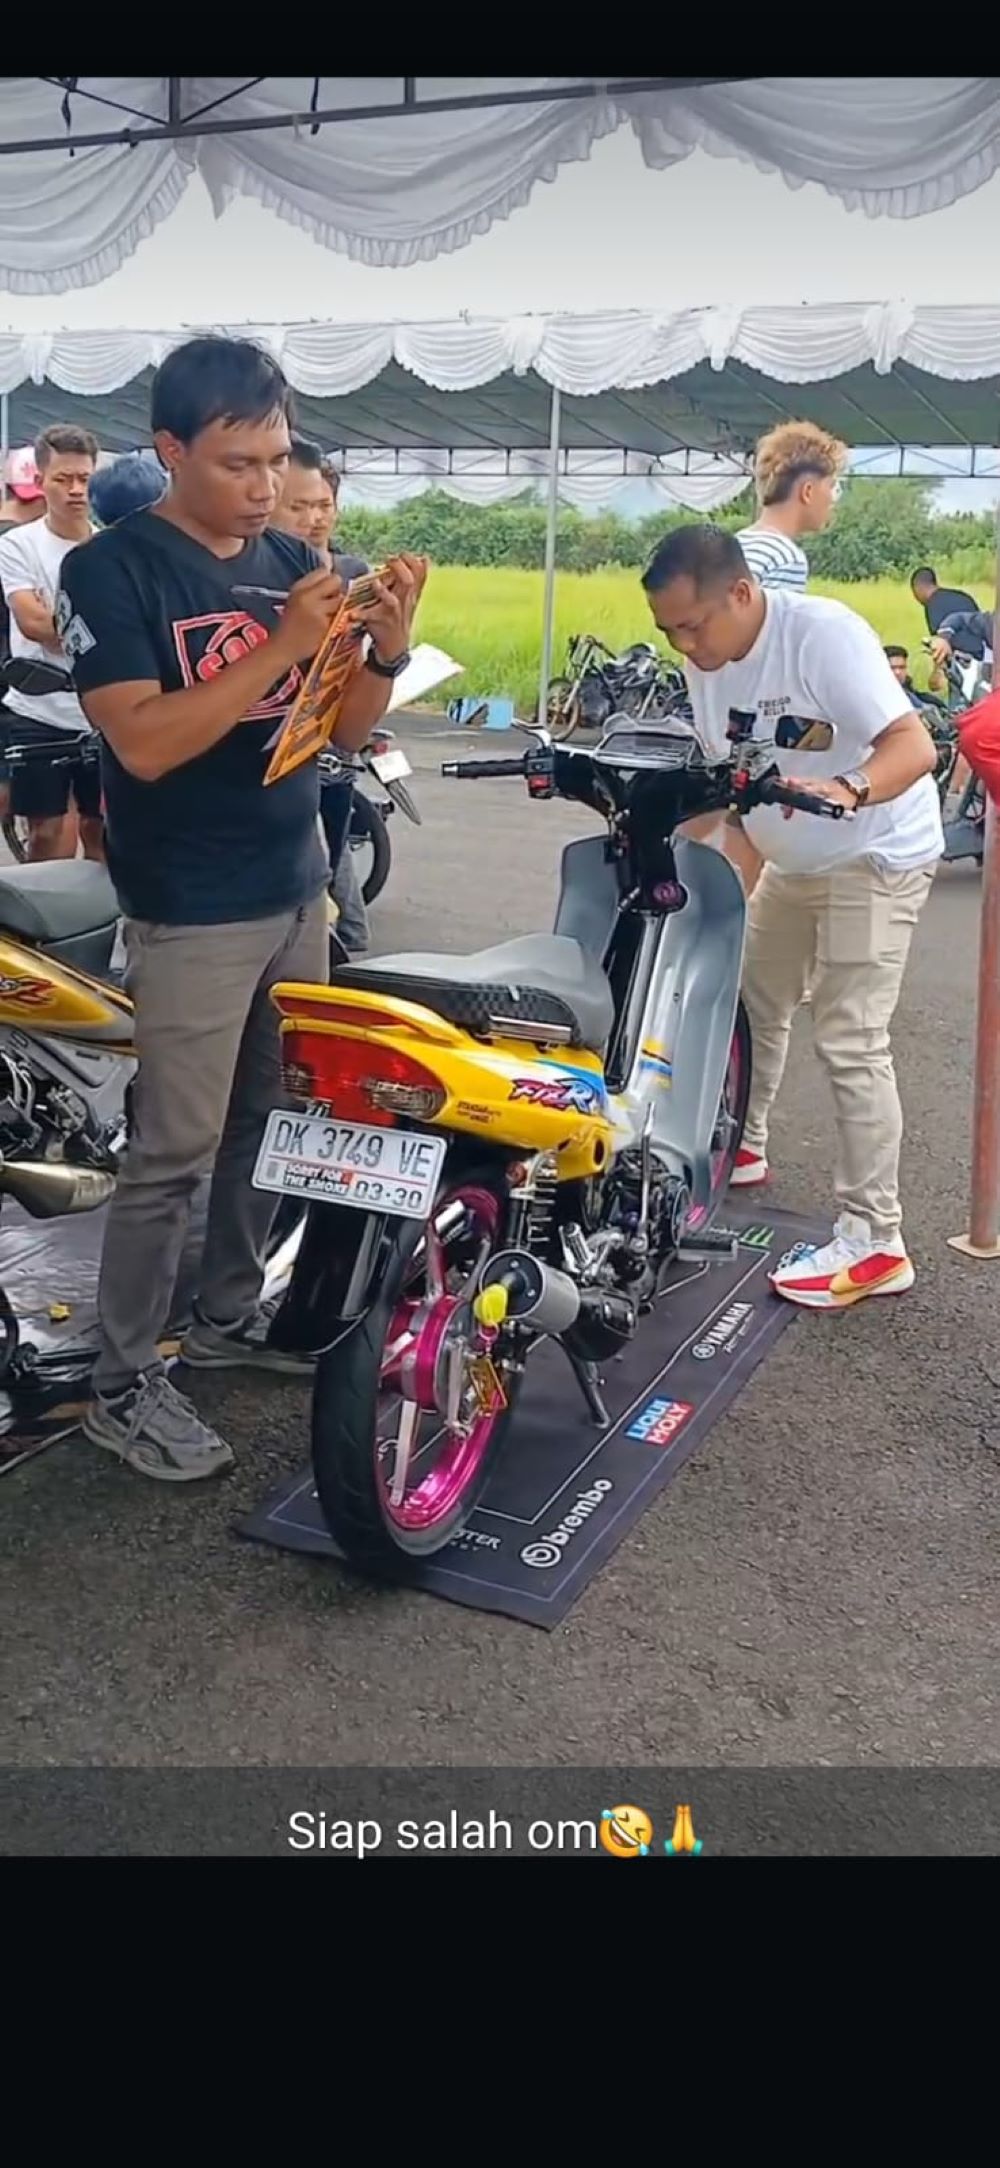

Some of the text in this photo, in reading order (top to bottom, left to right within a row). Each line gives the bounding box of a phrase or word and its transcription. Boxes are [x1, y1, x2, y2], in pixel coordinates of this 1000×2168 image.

[272, 1119, 434, 1178] DK 3749 VE
[700, 1302, 753, 1345] YAMAHA
[624, 1398, 672, 1439] LIQUI
[646, 1402, 689, 1444] MOLY
[542, 1479, 613, 1546] brembo
